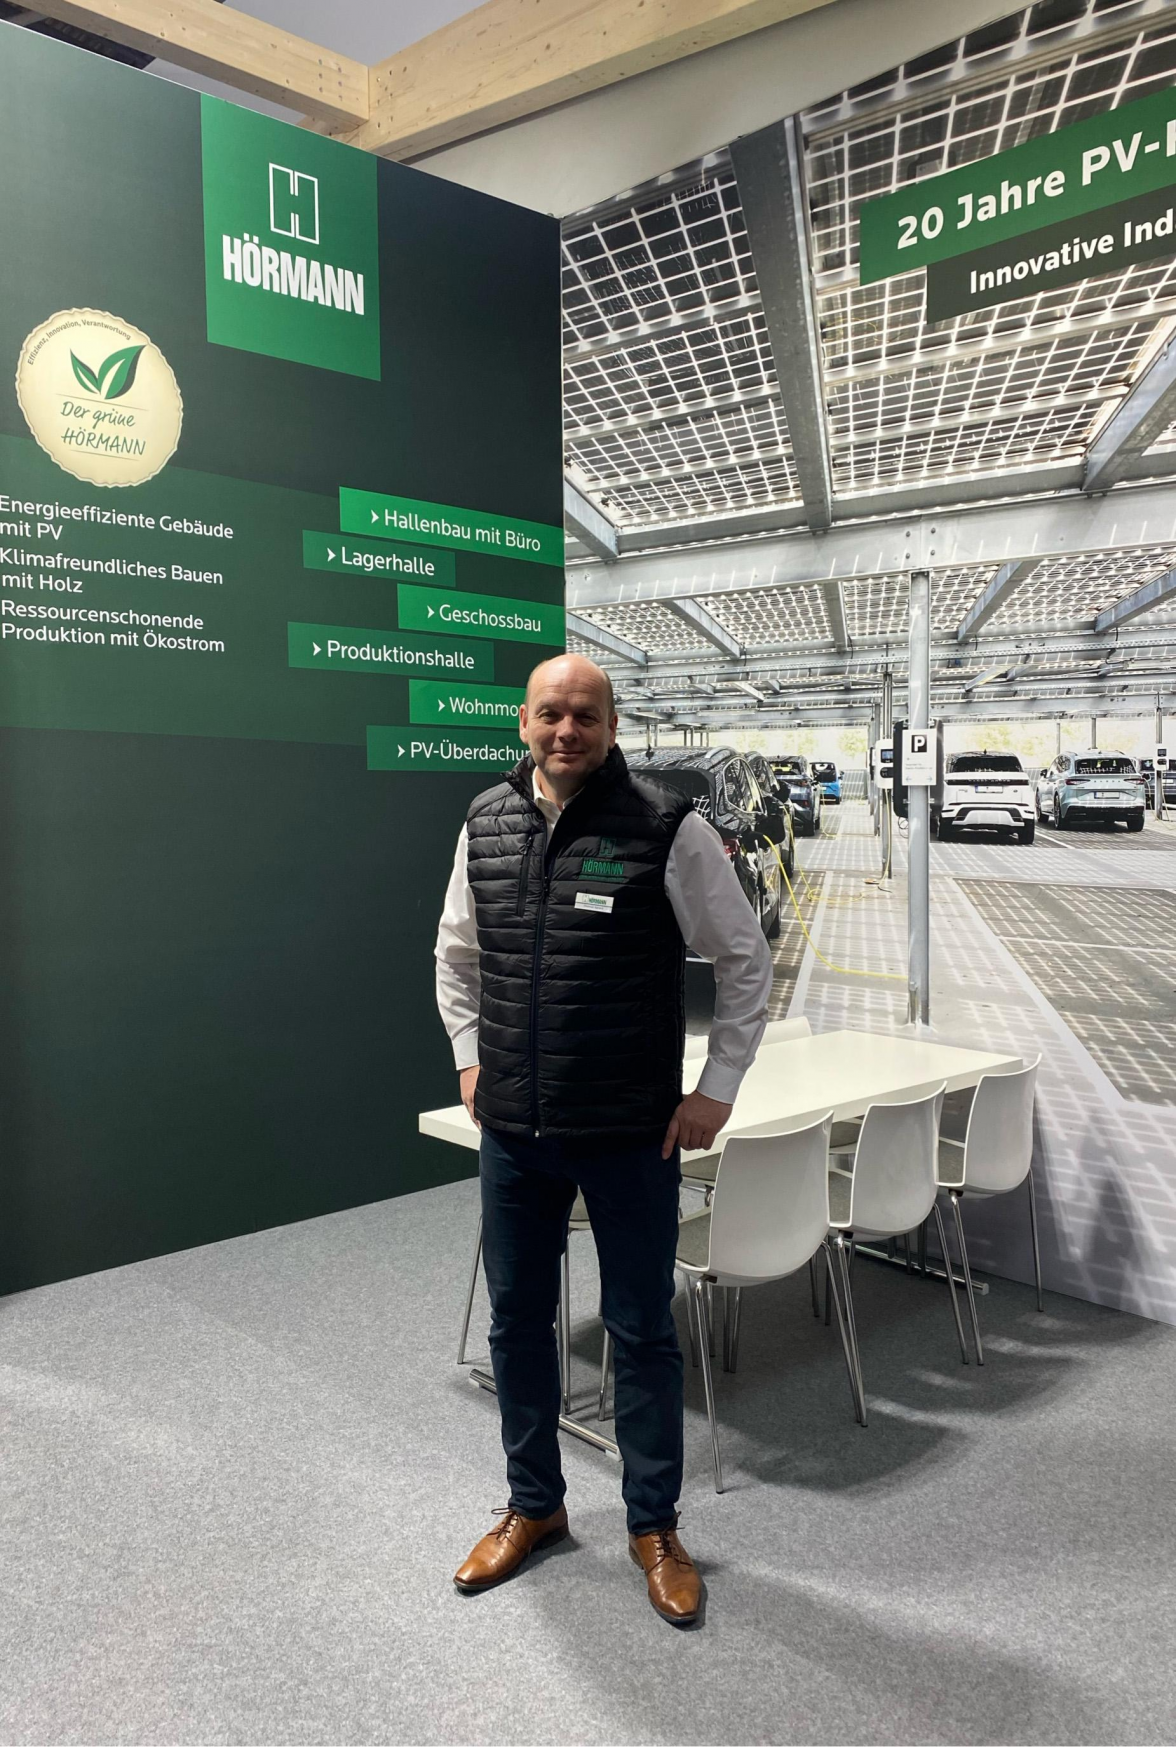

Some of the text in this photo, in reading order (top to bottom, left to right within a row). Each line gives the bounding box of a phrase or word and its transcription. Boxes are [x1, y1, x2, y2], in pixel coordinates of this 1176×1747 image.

[897, 206, 944, 249] 20
[957, 170, 1066, 229] Jahre
[970, 207, 1176, 294] Innovative Ind
[222, 232, 365, 316] HÖRMANN
[27, 319, 132, 366] Effizienz, Innovation, Verantwortung
[60, 400, 136, 429] Der grüne
[61, 427, 147, 456] HÖRMANN
[0, 494, 234, 539] Energieeffiziente Gebäude
[0, 520, 63, 541] mit PV
[384, 508, 541, 551] Hallenbau mit Büro
[0, 547, 223, 585] Klimafreundliches Bauen
[341, 546, 435, 576] Lagerhalle
[2, 572, 83, 593] mit Holz
[1, 599, 204, 630] Ressourcenschonende
[439, 604, 541, 632] Geschossbau
[1, 622, 225, 652] Produktion mit Ökostrom
[327, 640, 475, 670] Produktionshalle
[449, 696, 520, 717] Wohnmo
[582, 859, 624, 875] HÖRMANN
